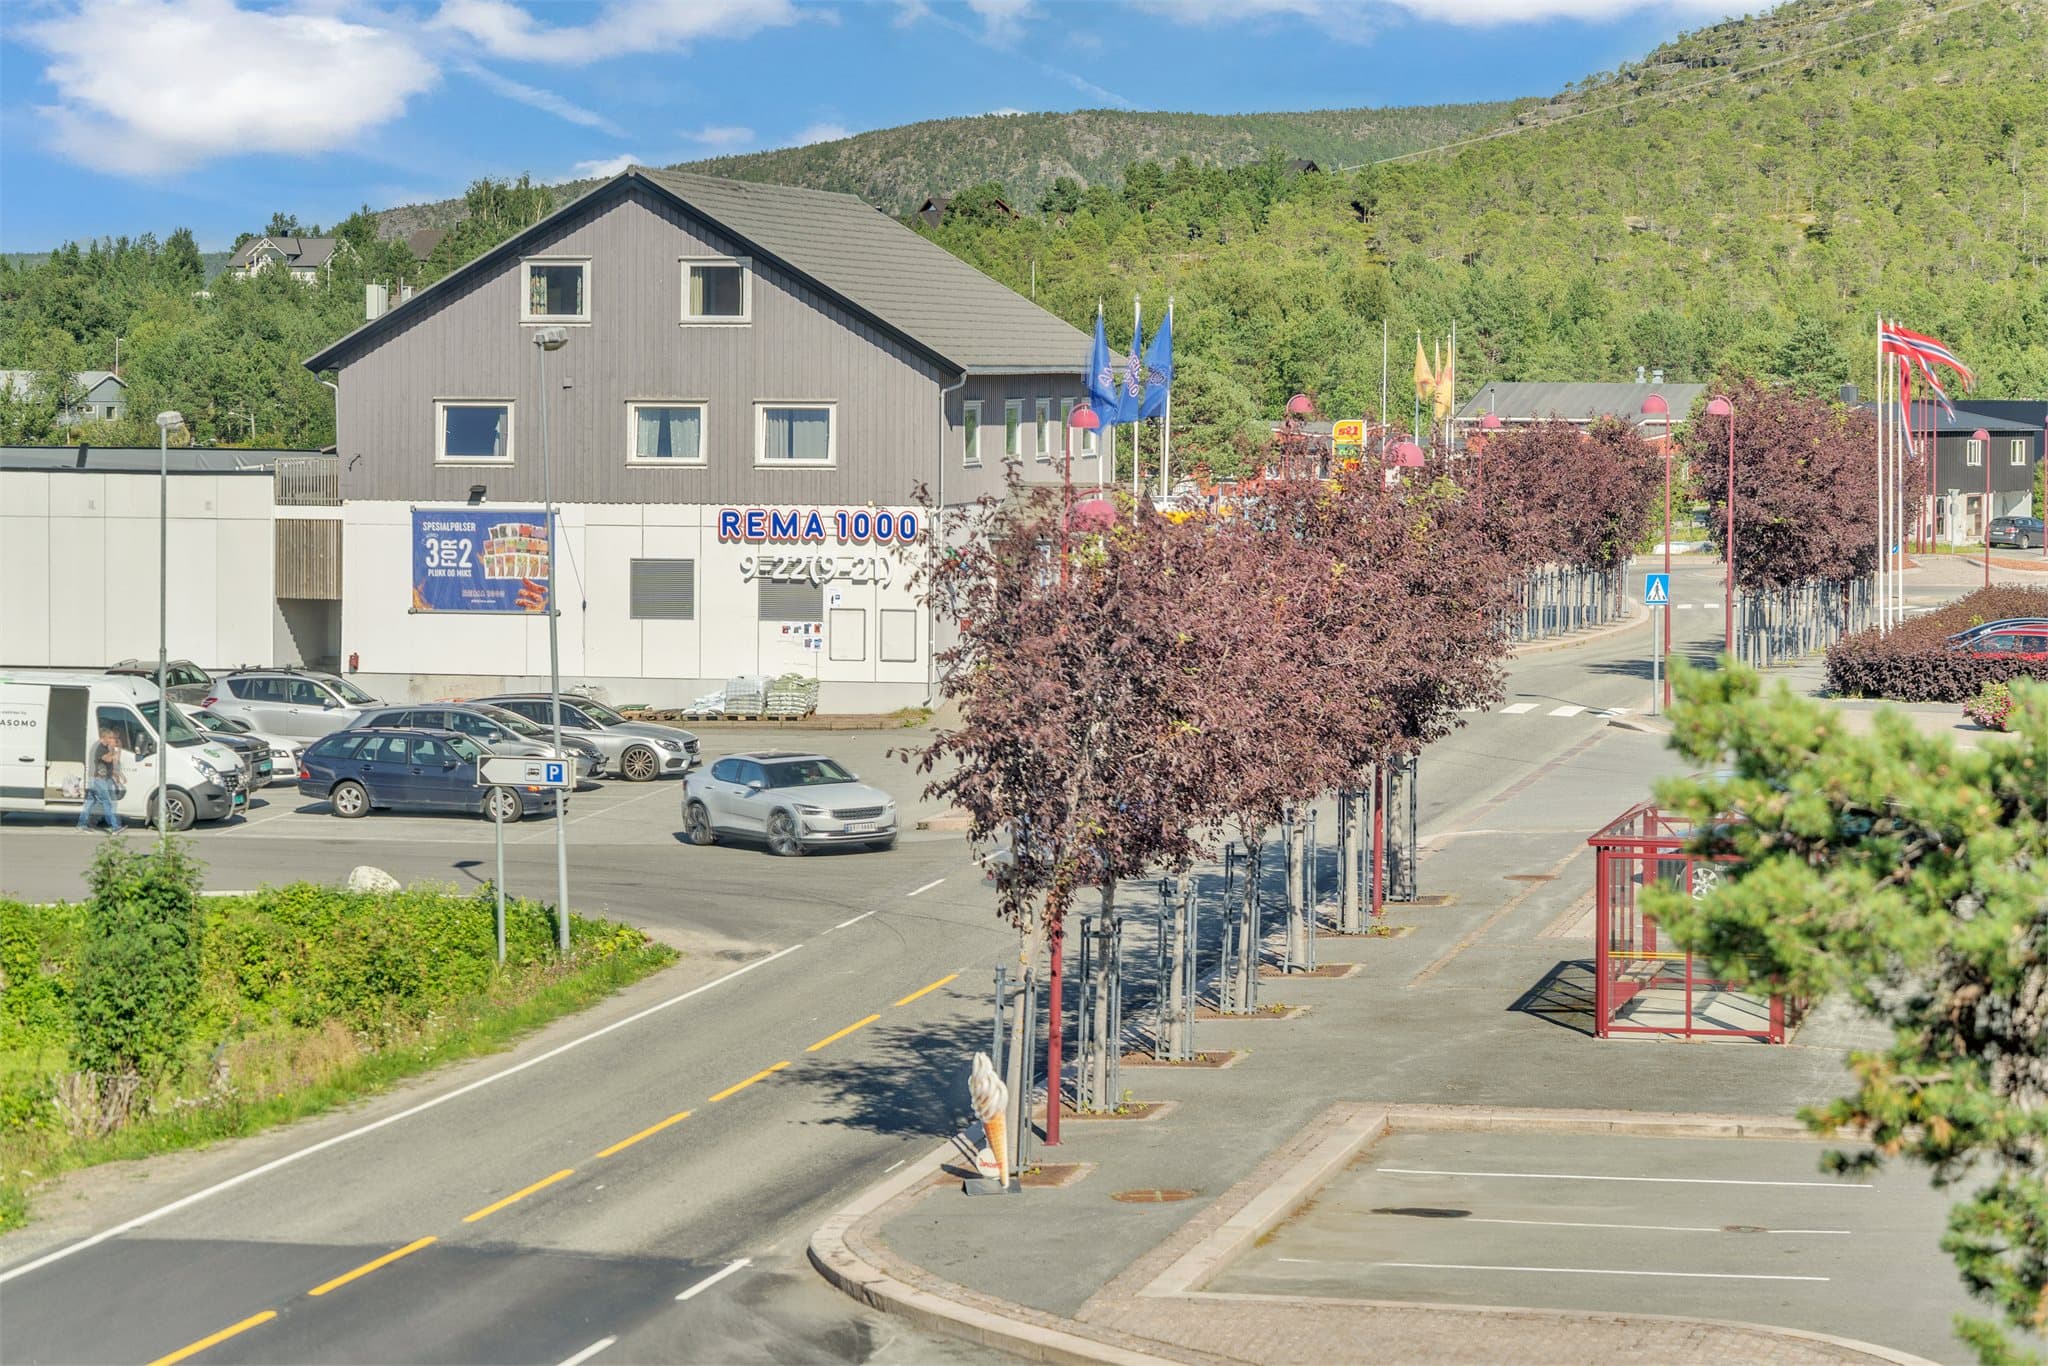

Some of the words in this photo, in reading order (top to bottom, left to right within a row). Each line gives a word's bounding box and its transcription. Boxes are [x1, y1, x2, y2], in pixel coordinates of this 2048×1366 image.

[719, 508, 826, 541] REMA
[835, 509, 918, 542] 1000
[425, 538, 439, 568] 3
[440, 539, 458, 567] FOR
[458, 538, 473, 568] 2
[427, 568, 446, 577] PLUKK
[549, 765, 560, 780] P
